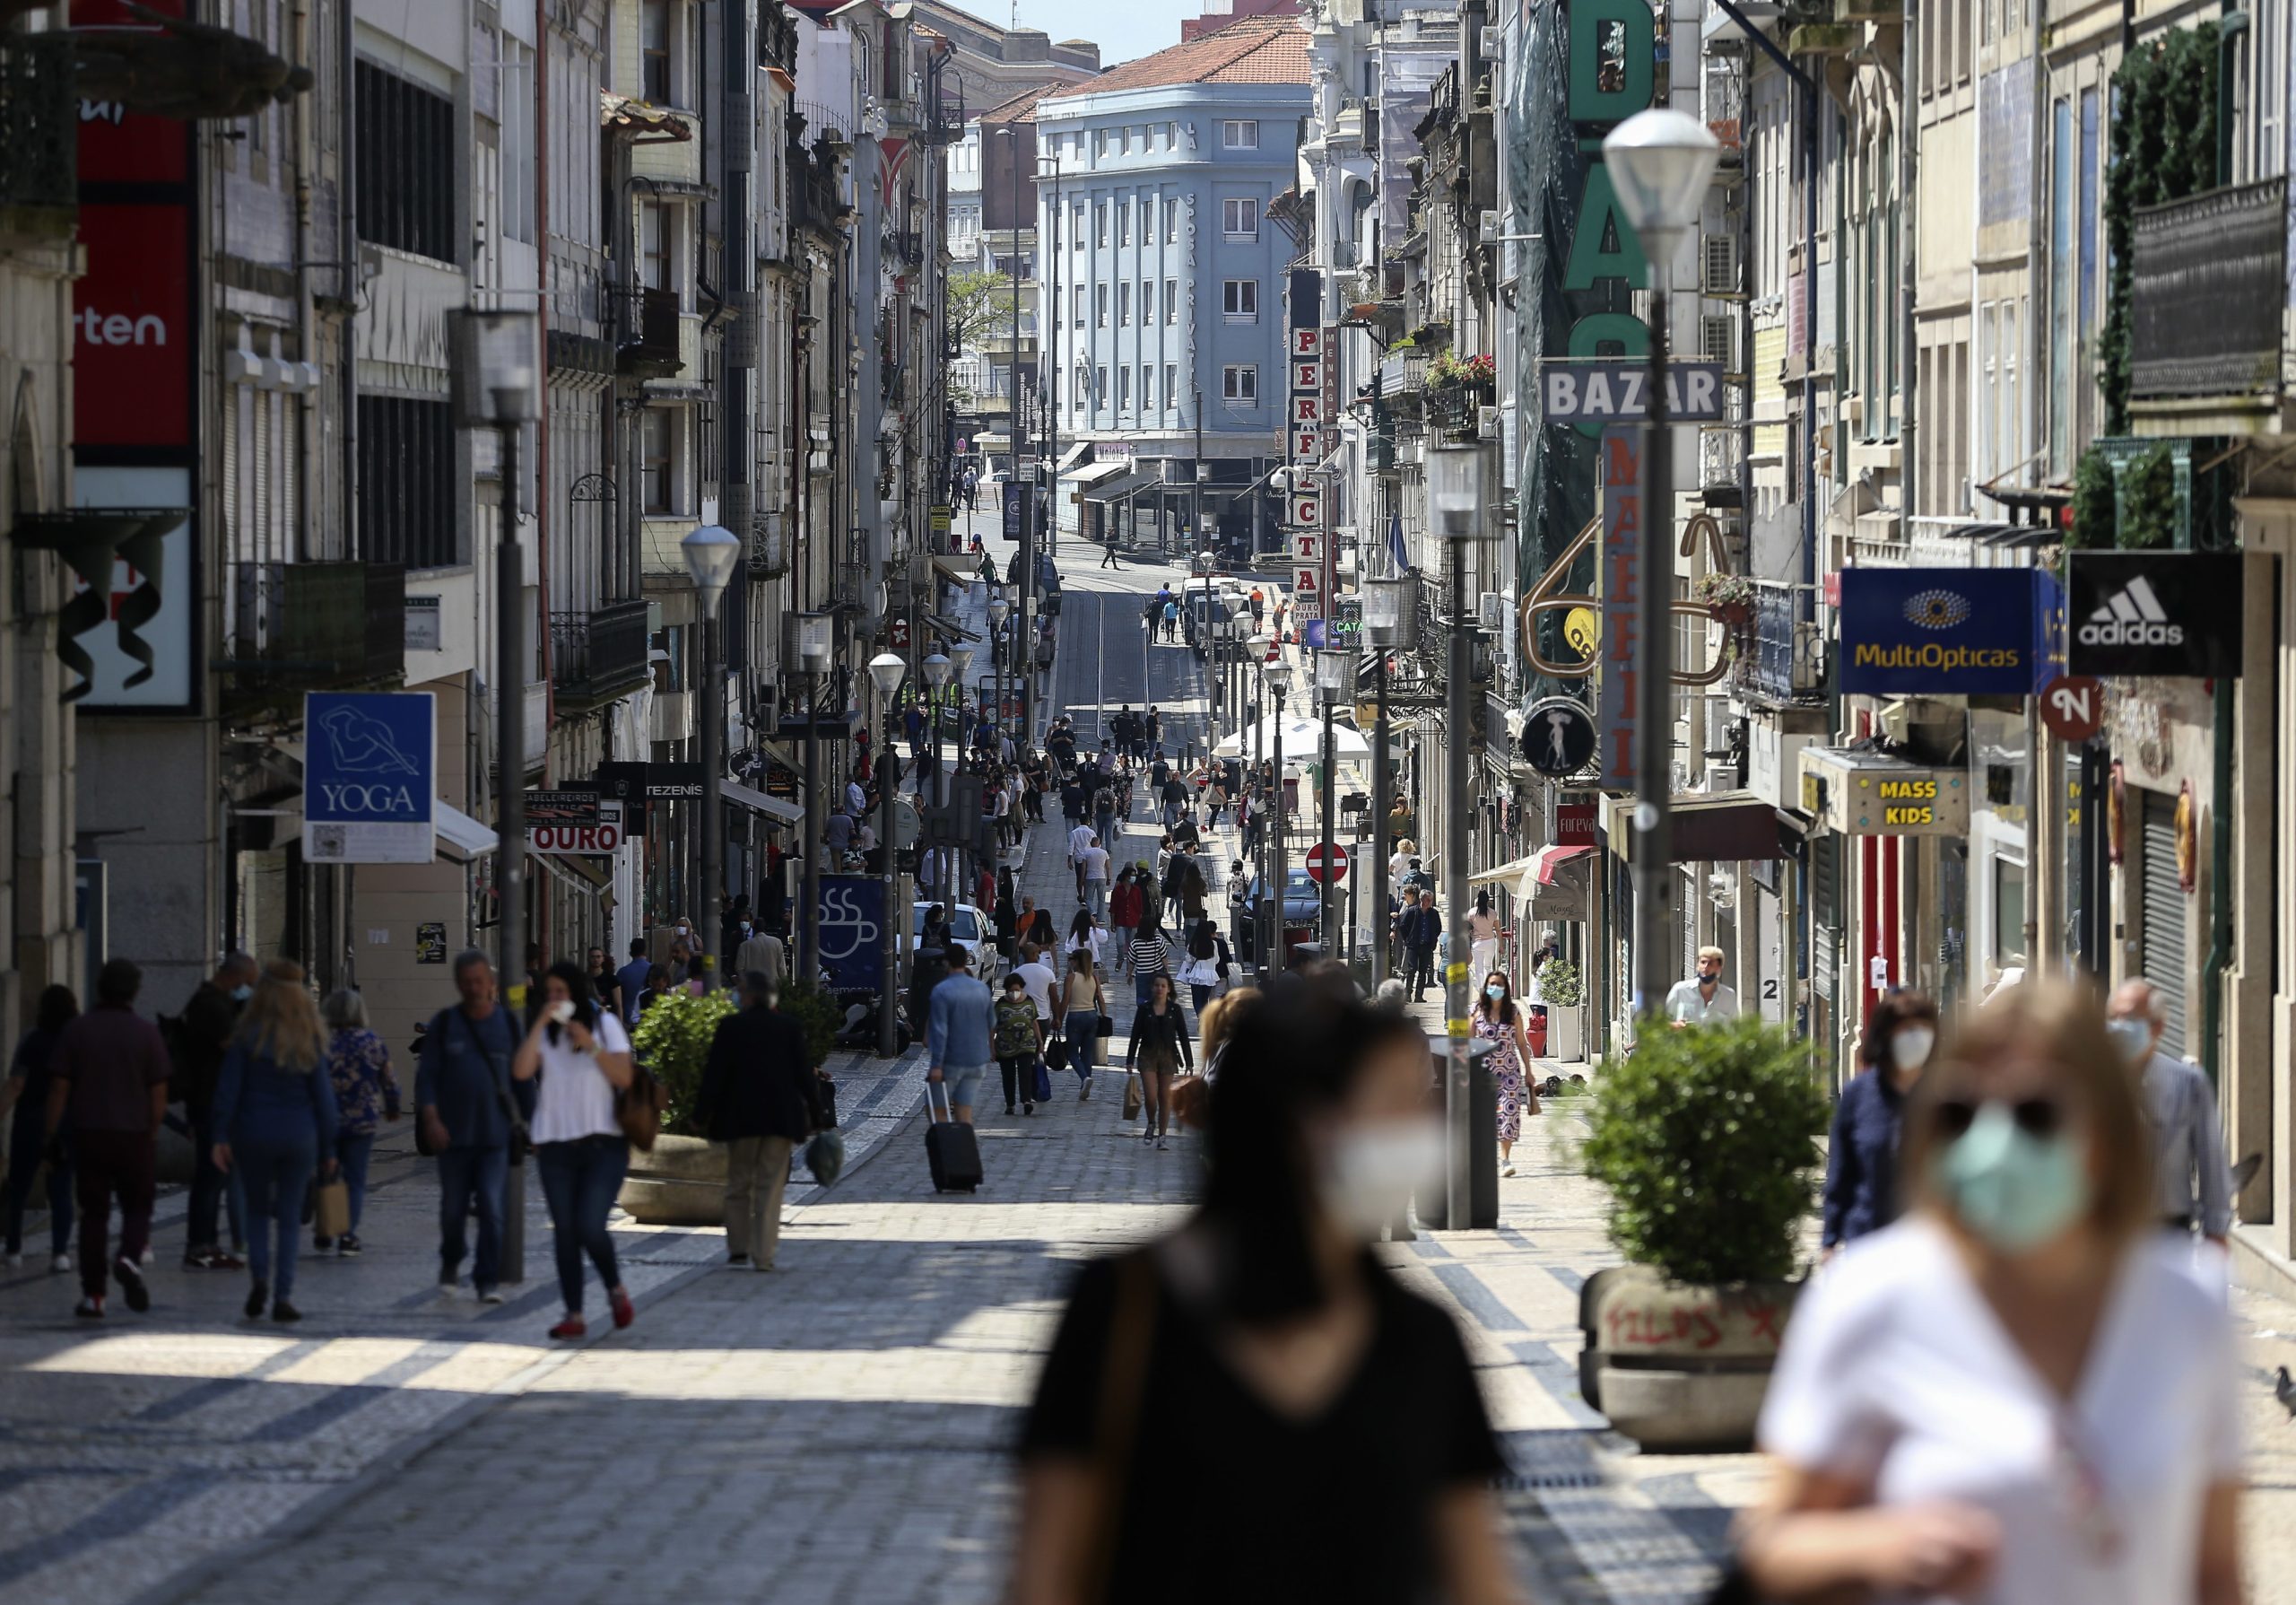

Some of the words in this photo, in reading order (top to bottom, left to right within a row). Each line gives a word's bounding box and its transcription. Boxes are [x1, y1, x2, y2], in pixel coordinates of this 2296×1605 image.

[1186, 193, 1196, 266] SPOSA
[1325, 335, 1335, 418] MENAGE
[1548, 371, 1718, 416] BAZAR
[1295, 604, 1318, 612] OURO
[2078, 620, 2185, 647] adidas
[1854, 642, 2020, 672] MultiOpticas
[320, 783, 417, 813] YOGA
[646, 783, 703, 796] TEZENIS
[1879, 780, 1938, 799] MASS
[600, 811, 618, 821] AMOS
[1885, 806, 1934, 825] KIDS
[535, 824, 618, 850] OURO
[1762, 979, 1779, 999] 2
